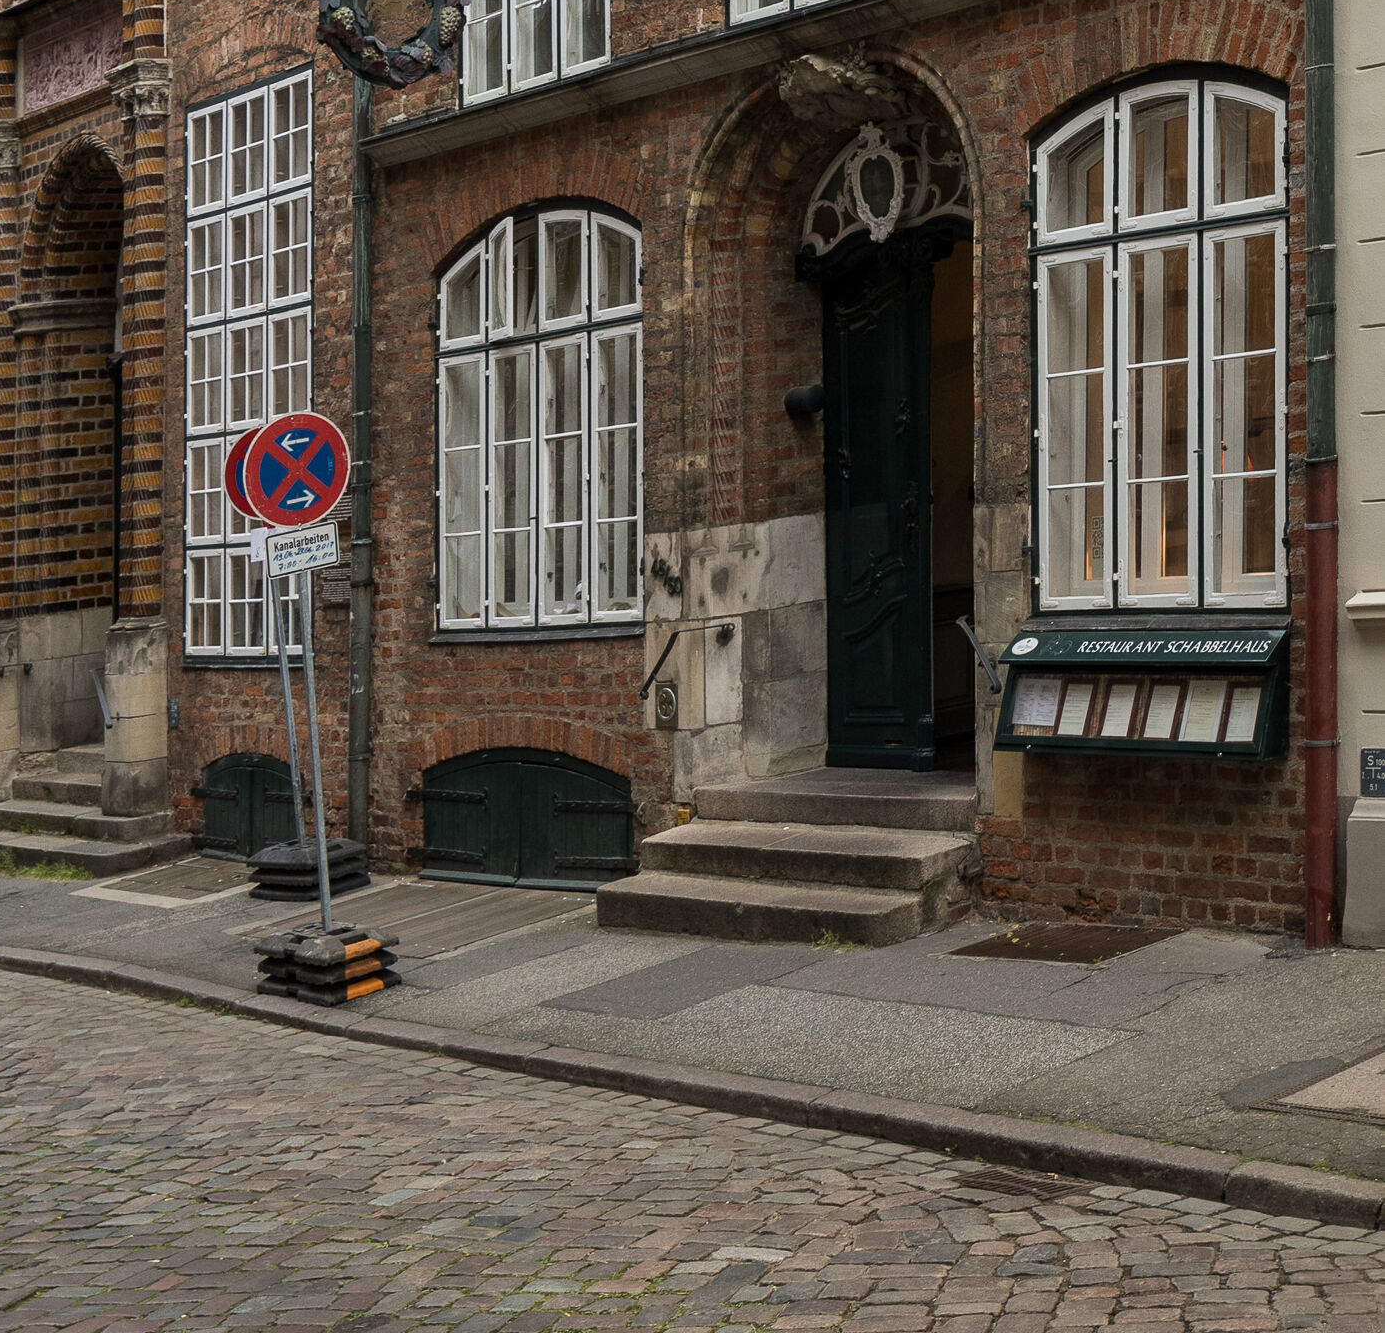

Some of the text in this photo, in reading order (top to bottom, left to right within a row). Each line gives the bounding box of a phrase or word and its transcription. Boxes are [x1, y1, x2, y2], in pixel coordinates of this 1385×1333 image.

[273, 533, 330, 553] Kanalarbeiten
[1077, 639, 1272, 654] RESTAURANT SCHABBELHAUS
[1367, 755, 1374, 766] S
